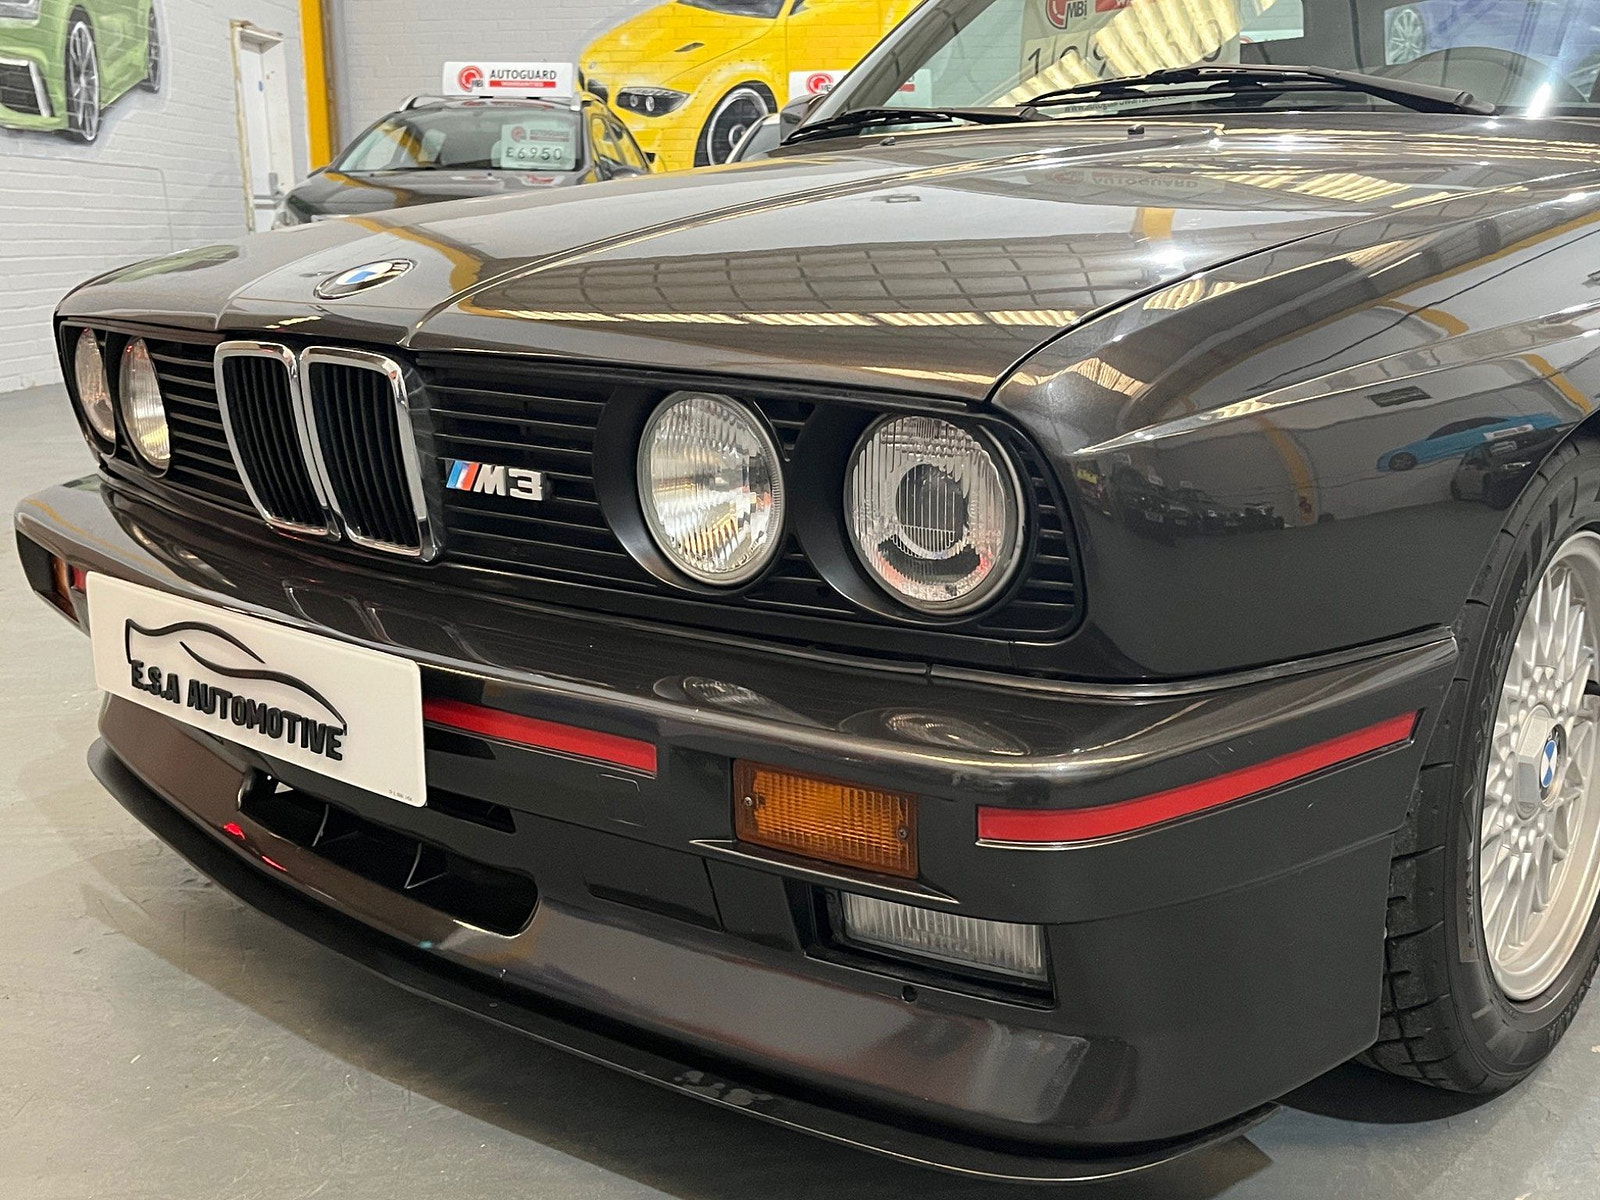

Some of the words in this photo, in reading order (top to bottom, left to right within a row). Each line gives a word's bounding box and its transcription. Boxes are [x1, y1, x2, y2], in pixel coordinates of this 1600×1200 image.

[490, 69, 557, 80] AUTOGUARD
[505, 146, 563, 161] £6950
[473, 464, 543, 500] M3
[131, 659, 180, 704] E.S.A
[187, 679, 343, 761] AUTOMOTIVE
